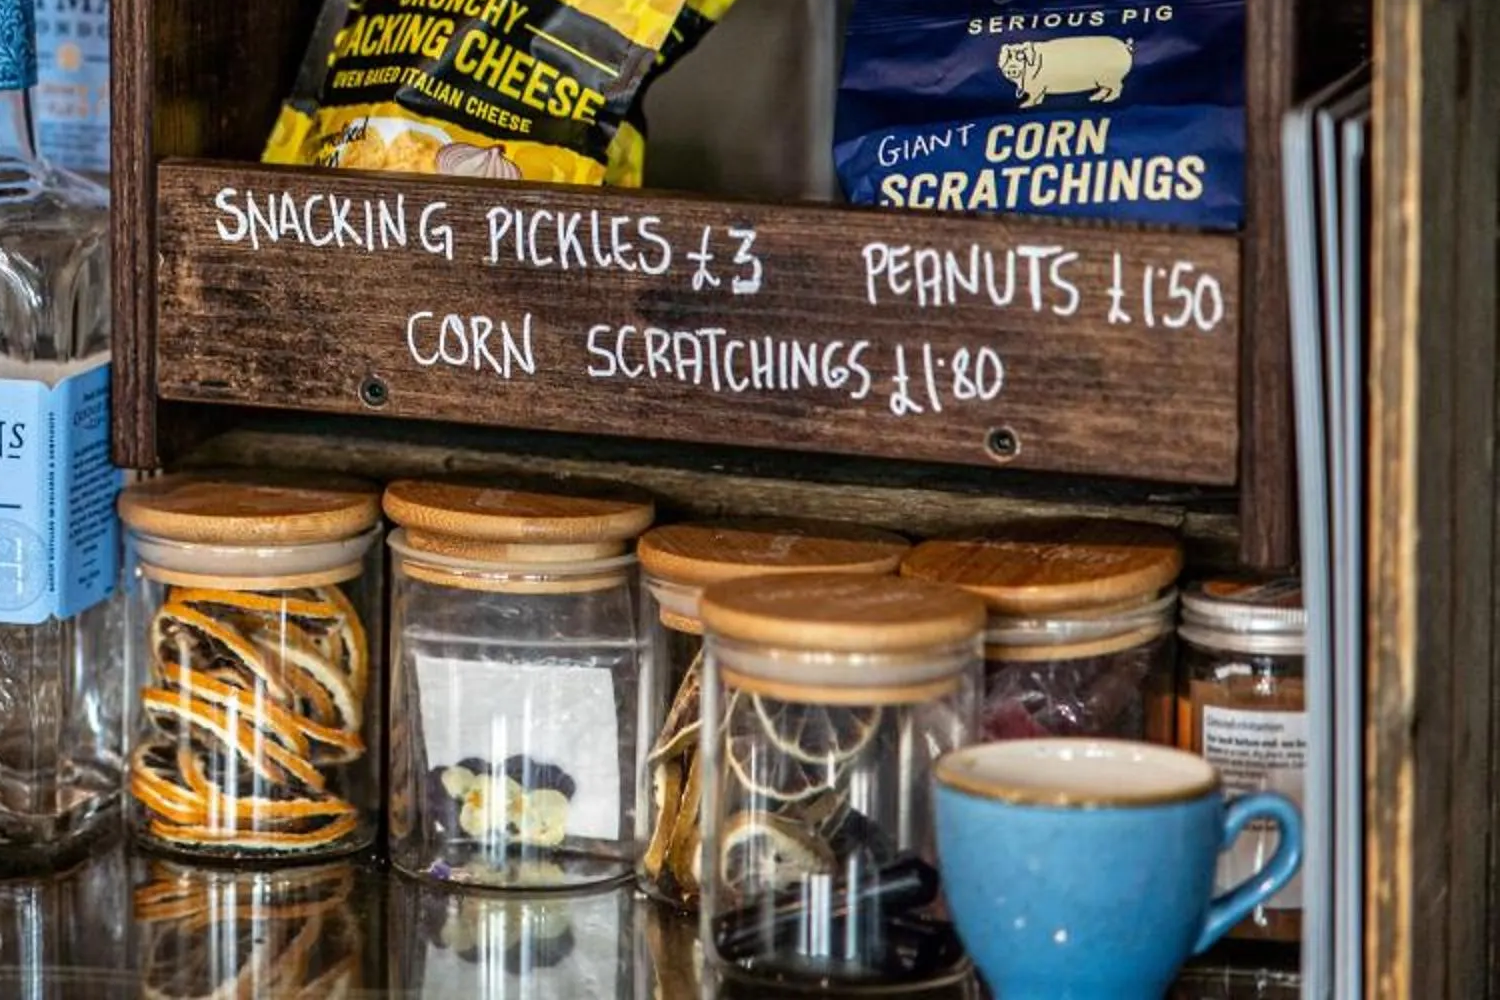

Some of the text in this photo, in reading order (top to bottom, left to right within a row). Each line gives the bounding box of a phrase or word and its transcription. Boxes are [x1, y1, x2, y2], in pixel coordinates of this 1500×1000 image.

[967, 4, 1174, 35] SERIOUS PIG
[327, 12, 607, 126] ACKING CHEESE
[365, 66, 399, 85] BAKED
[400, 66, 470, 109] ITALIAN
[465, 98, 534, 134] CHEESE
[877, 117, 1111, 168] GIANT CORN
[879, 154, 1206, 212] SCRATCHINGS
[214, 186, 454, 262] SNACKING
[485, 207, 673, 277] PICKLES
[686, 224, 763, 296] £3
[862, 241, 1081, 316] PEANUTS
[406, 310, 537, 380] CORN
[586, 324, 871, 400] SCRATCHINGS
